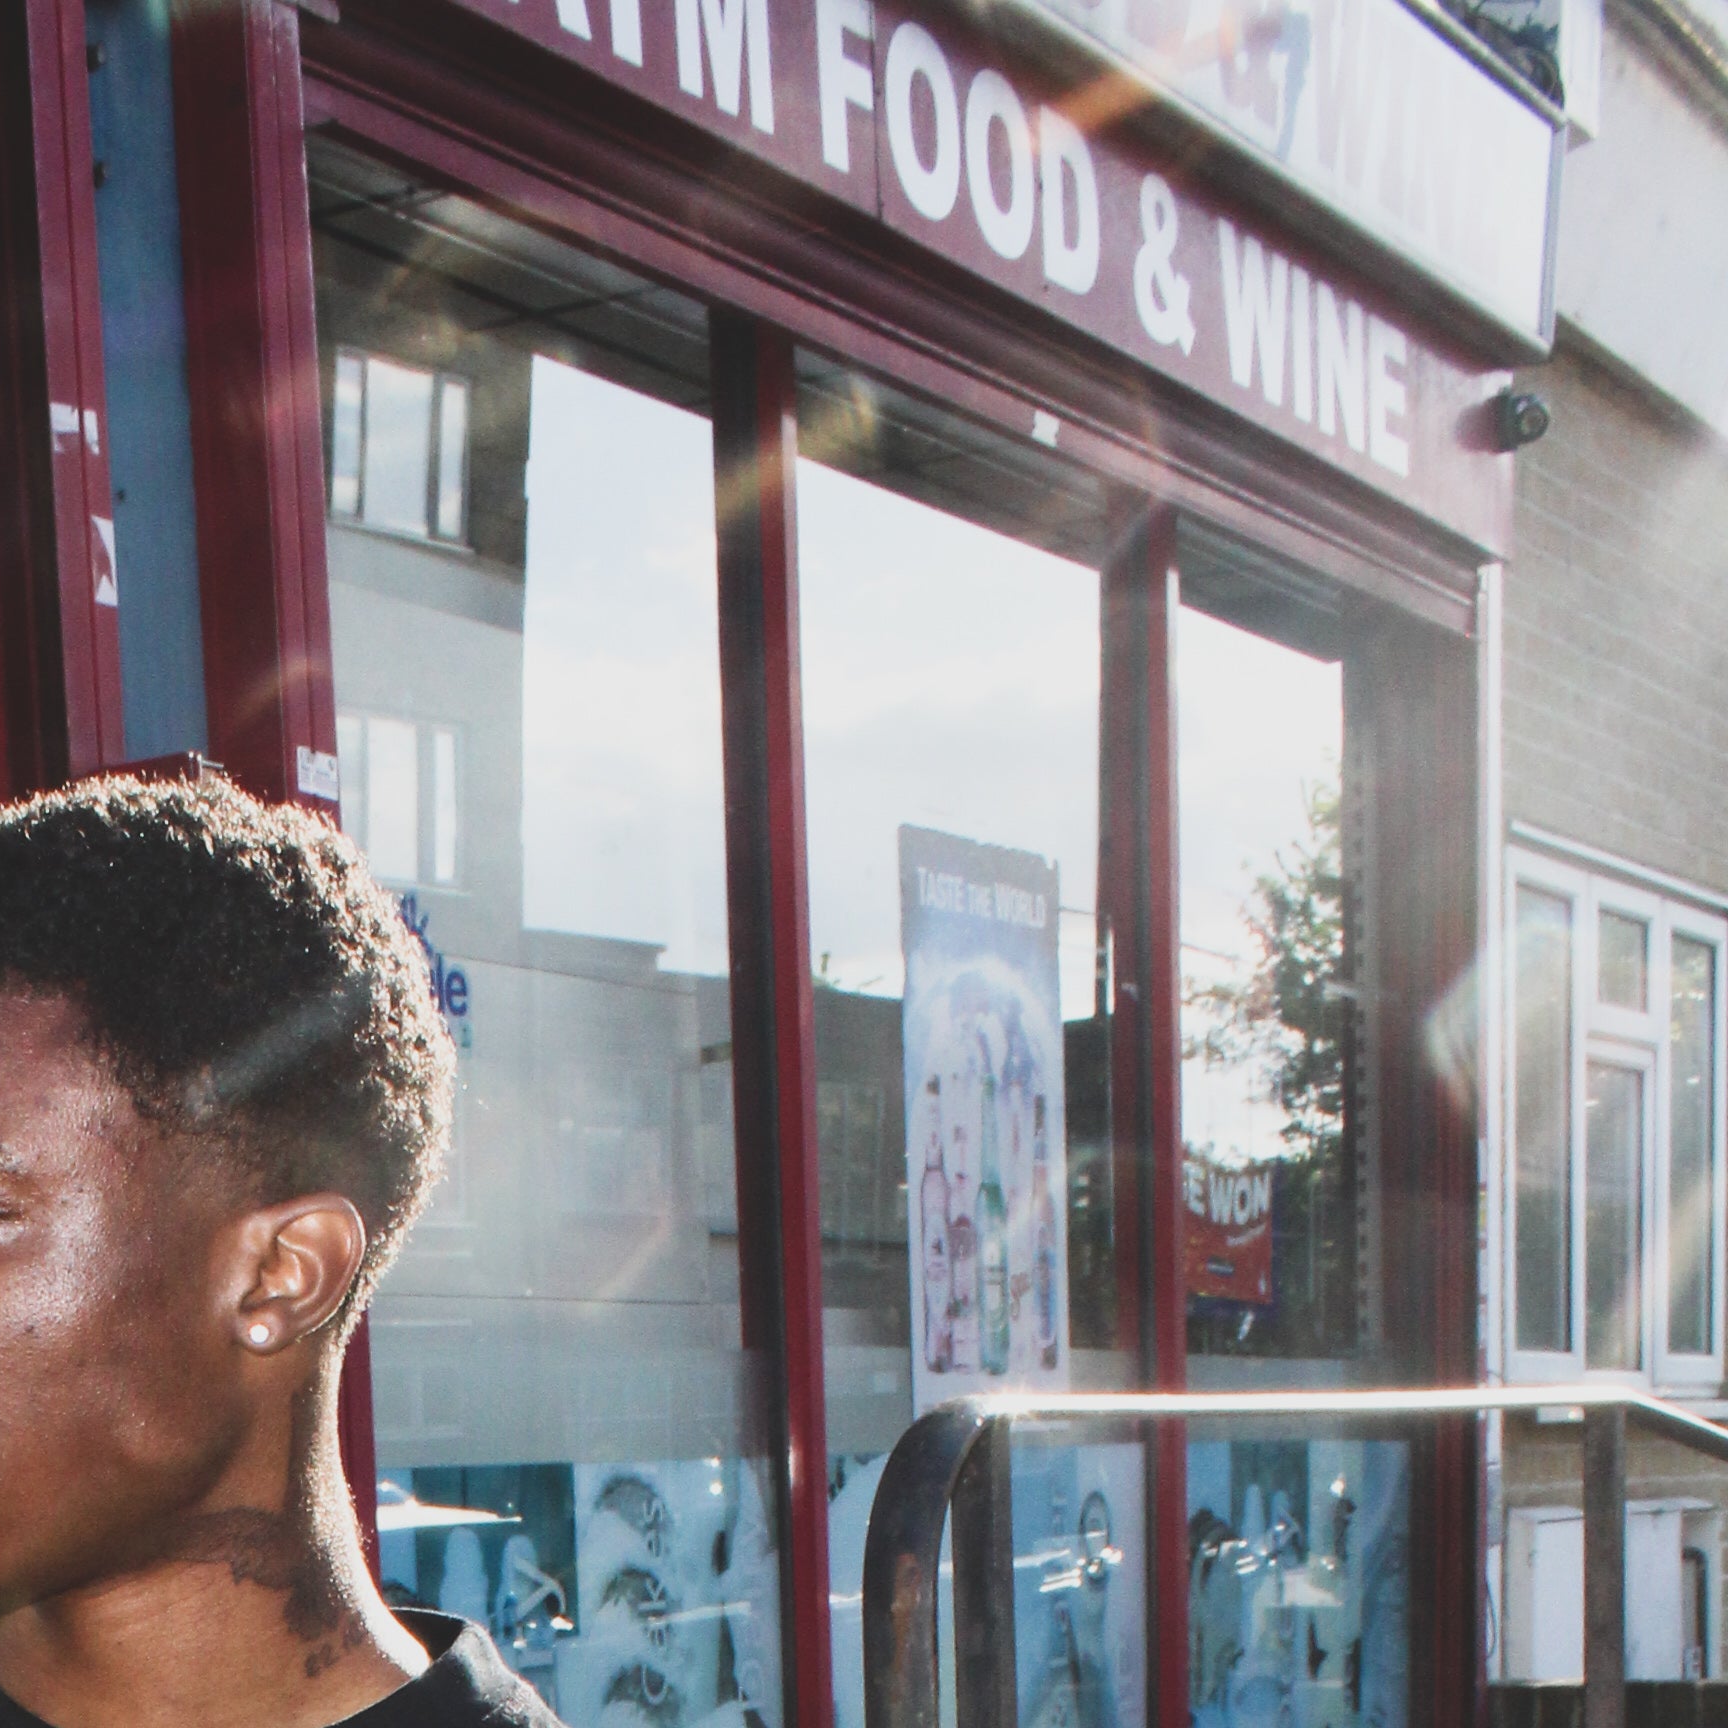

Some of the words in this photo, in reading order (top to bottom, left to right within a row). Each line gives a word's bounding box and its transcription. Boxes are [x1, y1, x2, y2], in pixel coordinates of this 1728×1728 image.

[816, 0, 1100, 296] FOOD
[1134, 173, 1196, 357] &
[1218, 216, 1409, 478] WINE
[917, 866, 966, 913] TASTE
[967, 881, 993, 920] THE
[994, 881, 1047, 930] WORLD
